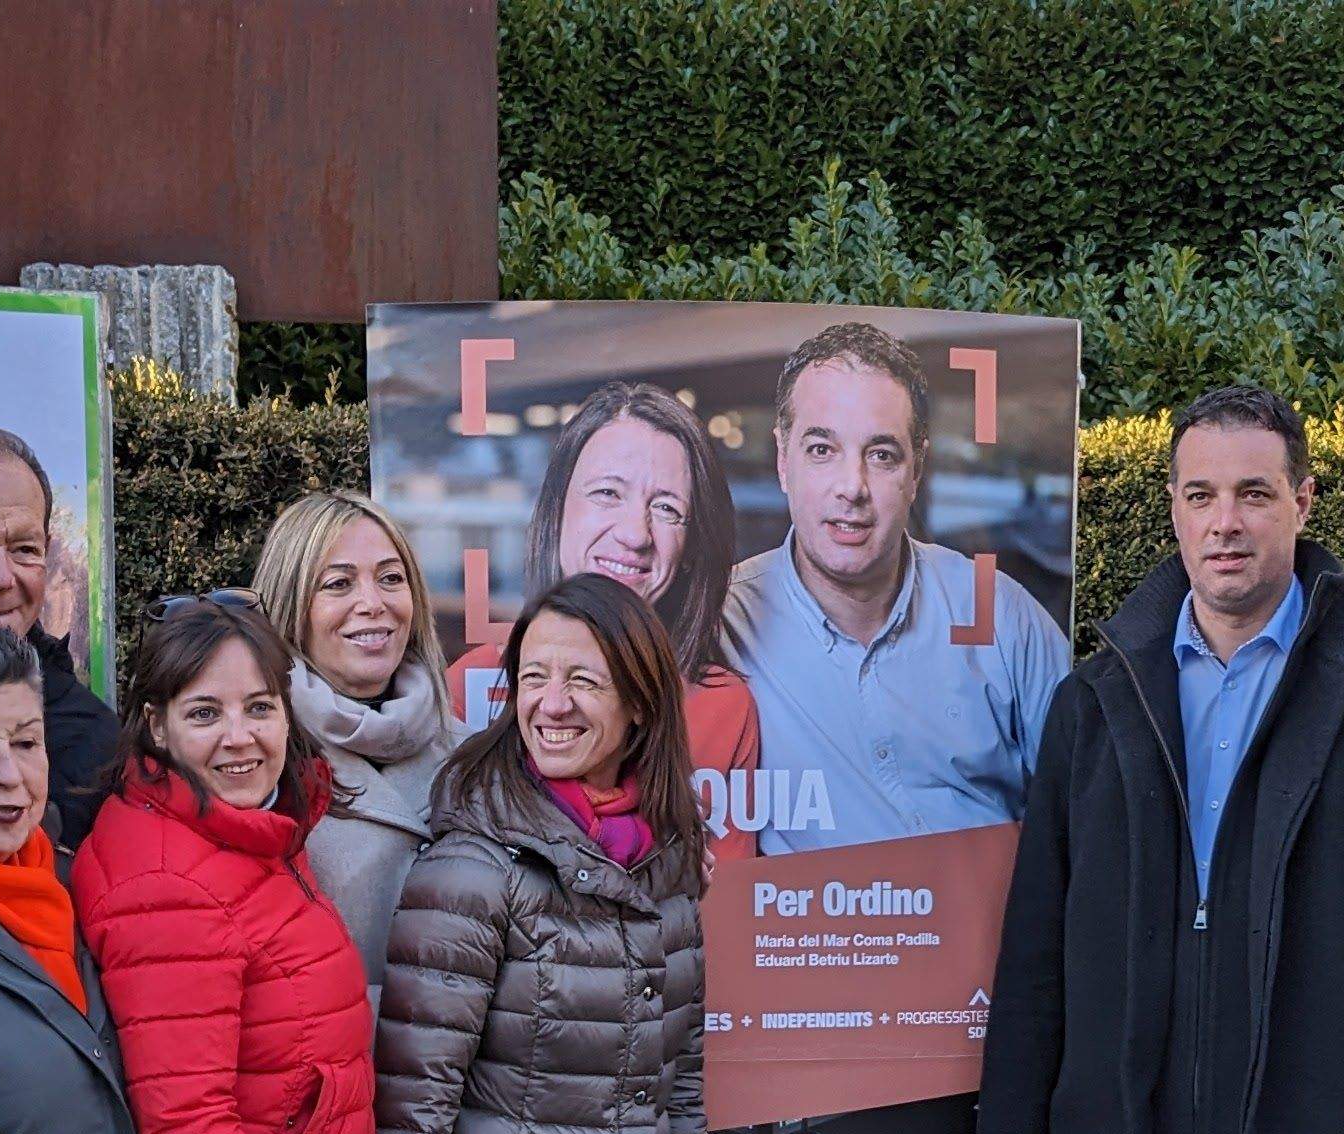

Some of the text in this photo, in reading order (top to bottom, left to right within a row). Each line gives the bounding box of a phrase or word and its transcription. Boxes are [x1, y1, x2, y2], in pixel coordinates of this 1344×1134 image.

[754, 881, 933, 917] Per Ordino
[755, 932, 940, 948] Maria del Mar Coma Padilla
[755, 952, 899, 967] Eduard Betriu Lizarte
[762, 1011, 873, 1029] INDEPENDENTS
[897, 1010, 990, 1025] PROGRESSISTES
